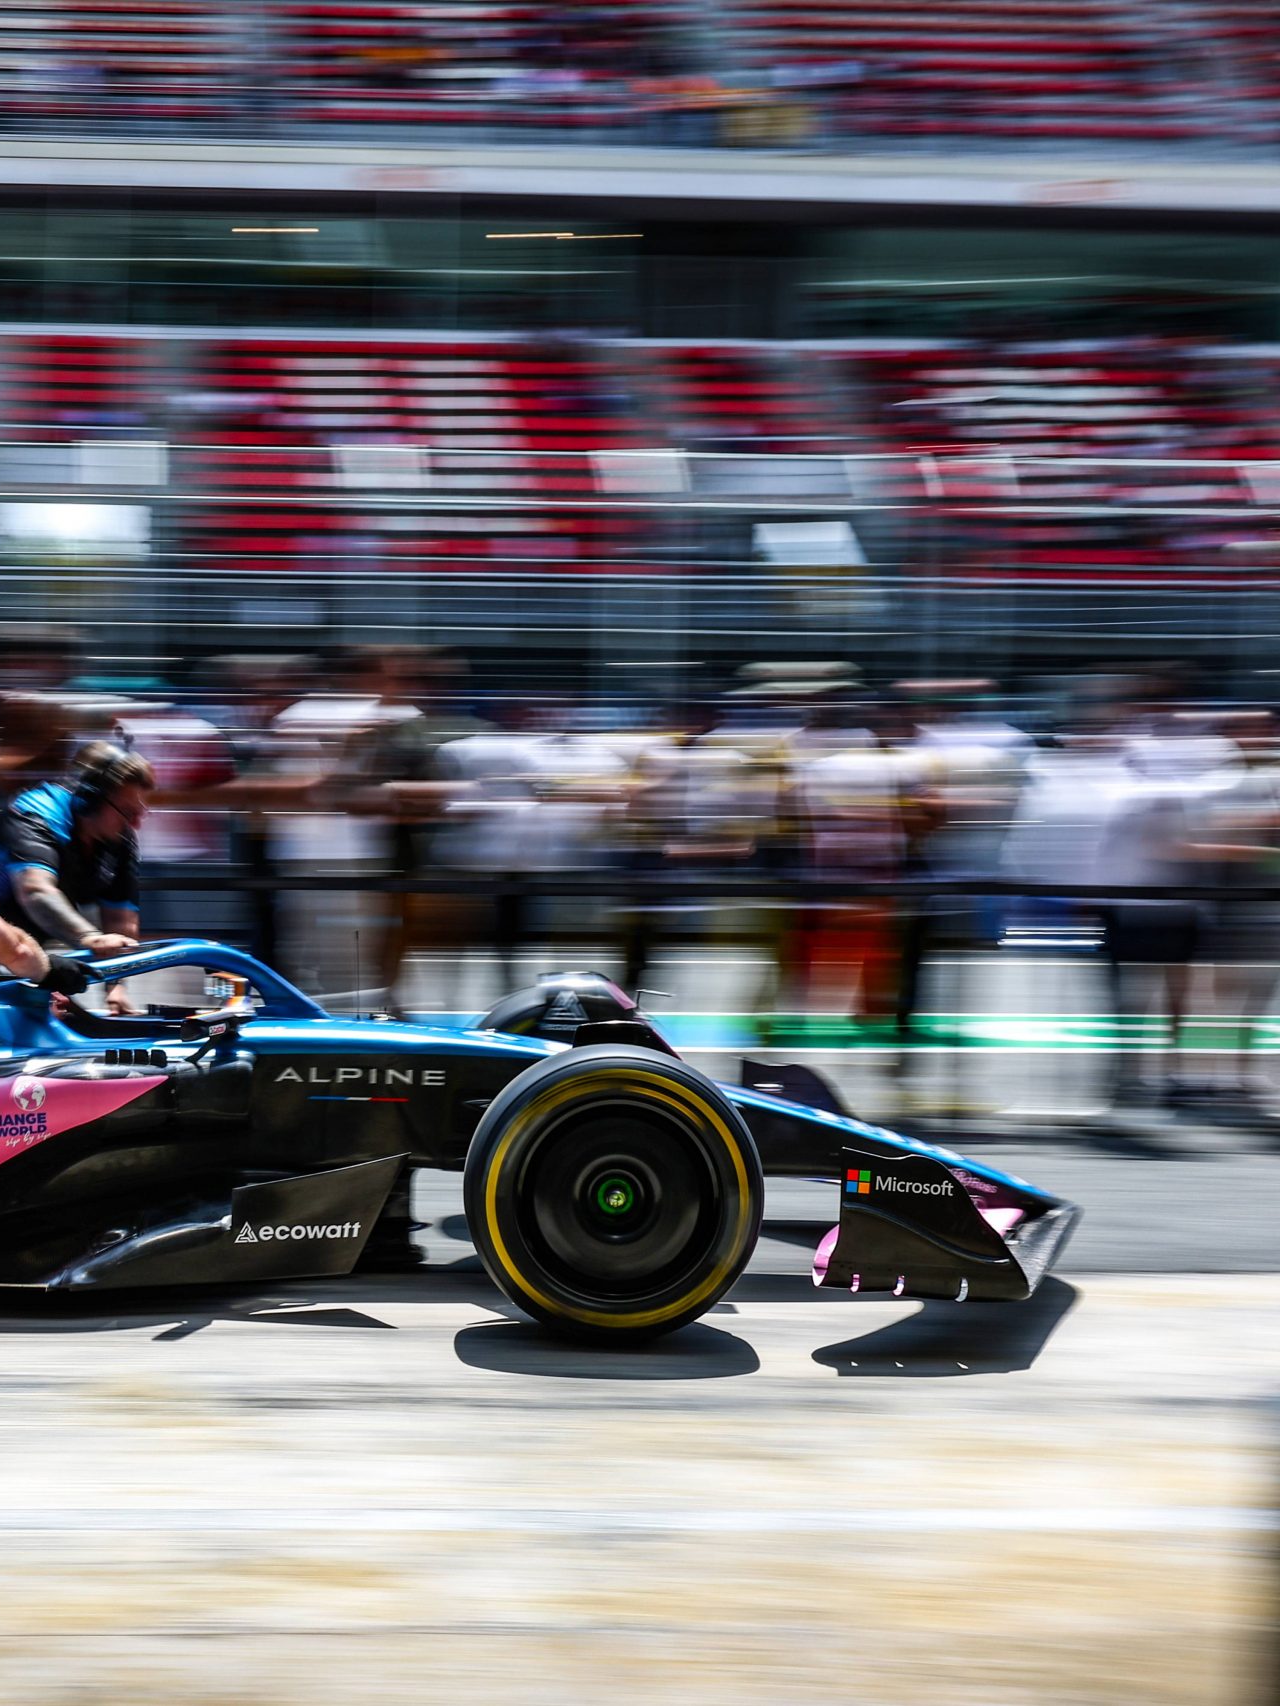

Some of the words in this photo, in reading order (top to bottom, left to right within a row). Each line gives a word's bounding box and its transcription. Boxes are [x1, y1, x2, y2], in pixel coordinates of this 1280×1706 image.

[274, 1066, 446, 1086] ALPINE
[875, 1176, 954, 1196] Microsoft
[258, 1221, 361, 1241] ecowatt
